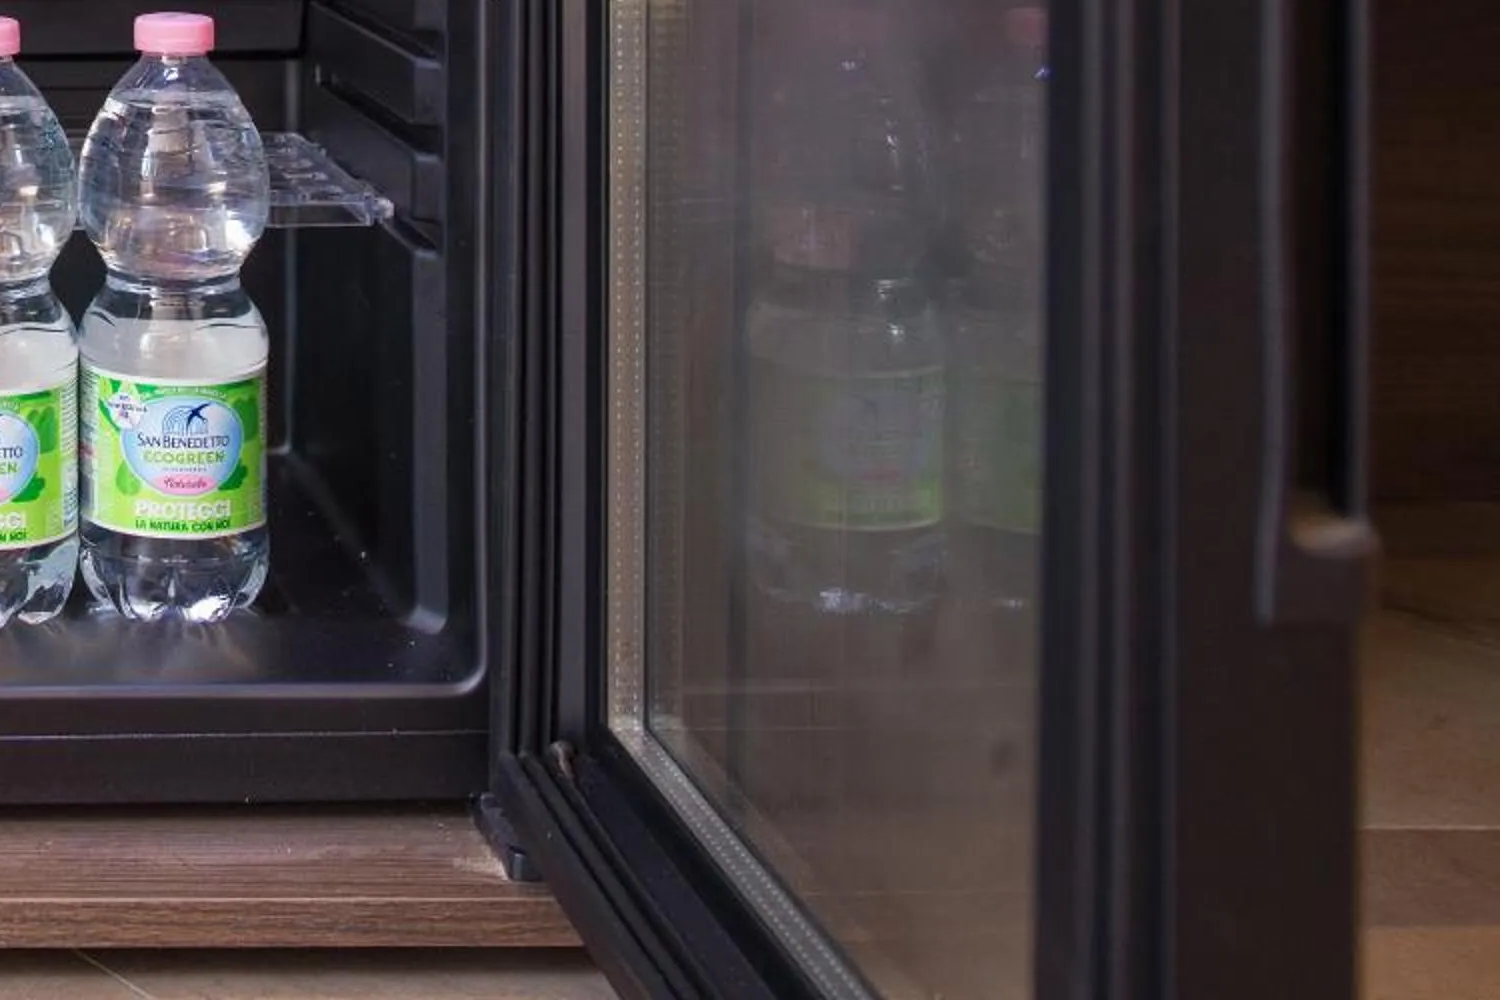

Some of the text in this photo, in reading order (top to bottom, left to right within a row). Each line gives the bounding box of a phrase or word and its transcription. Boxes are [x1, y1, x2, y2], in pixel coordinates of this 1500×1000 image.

[137, 432, 231, 449] SAN BENEDETTO
[143, 450, 226, 465] ECOGREEN
[135, 500, 231, 520] PROTEGGI
[135, 519, 147, 530] LA
